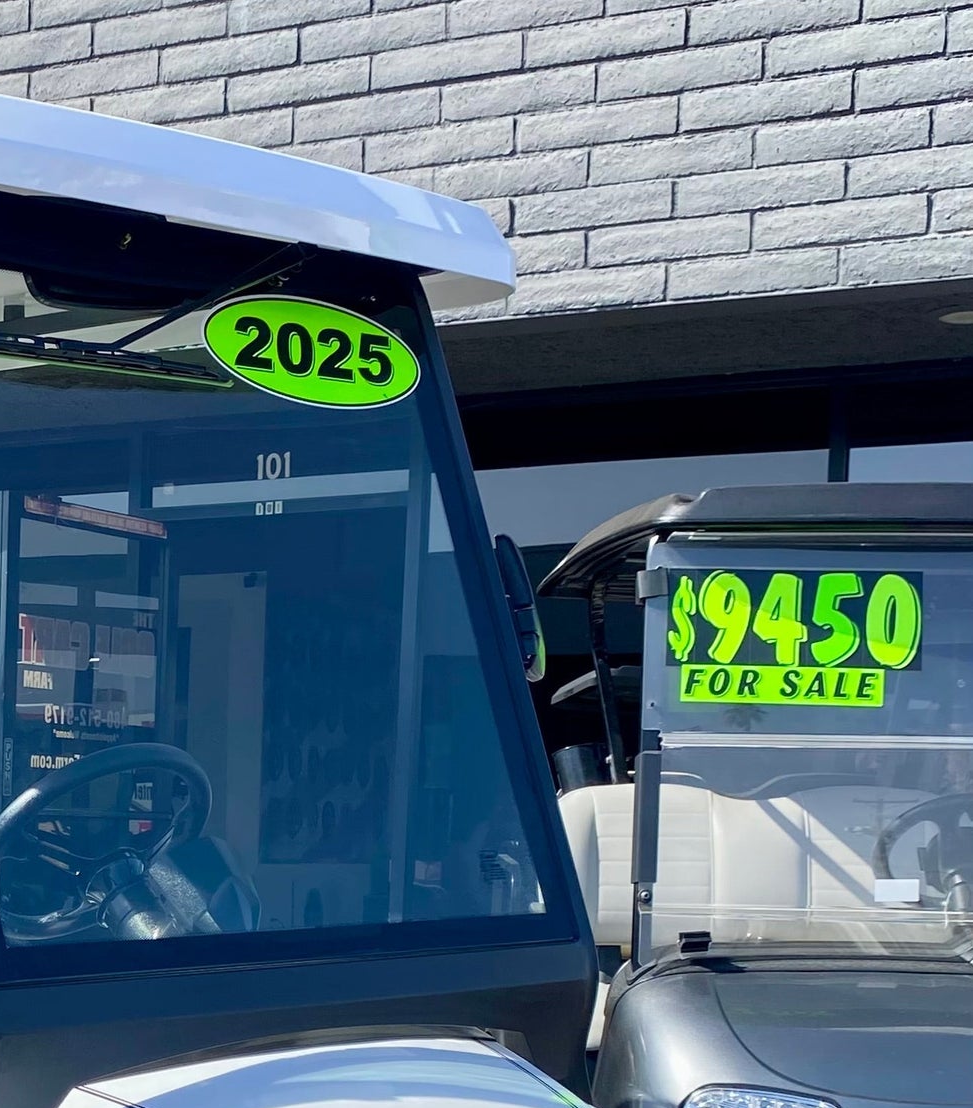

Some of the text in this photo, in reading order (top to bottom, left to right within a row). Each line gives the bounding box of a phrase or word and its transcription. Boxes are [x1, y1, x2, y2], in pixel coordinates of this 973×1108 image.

[234, 316, 394, 387] 2025
[256, 450, 291, 480] 101
[668, 570, 922, 670] $9450
[684, 668, 878, 700] FOR SALE
